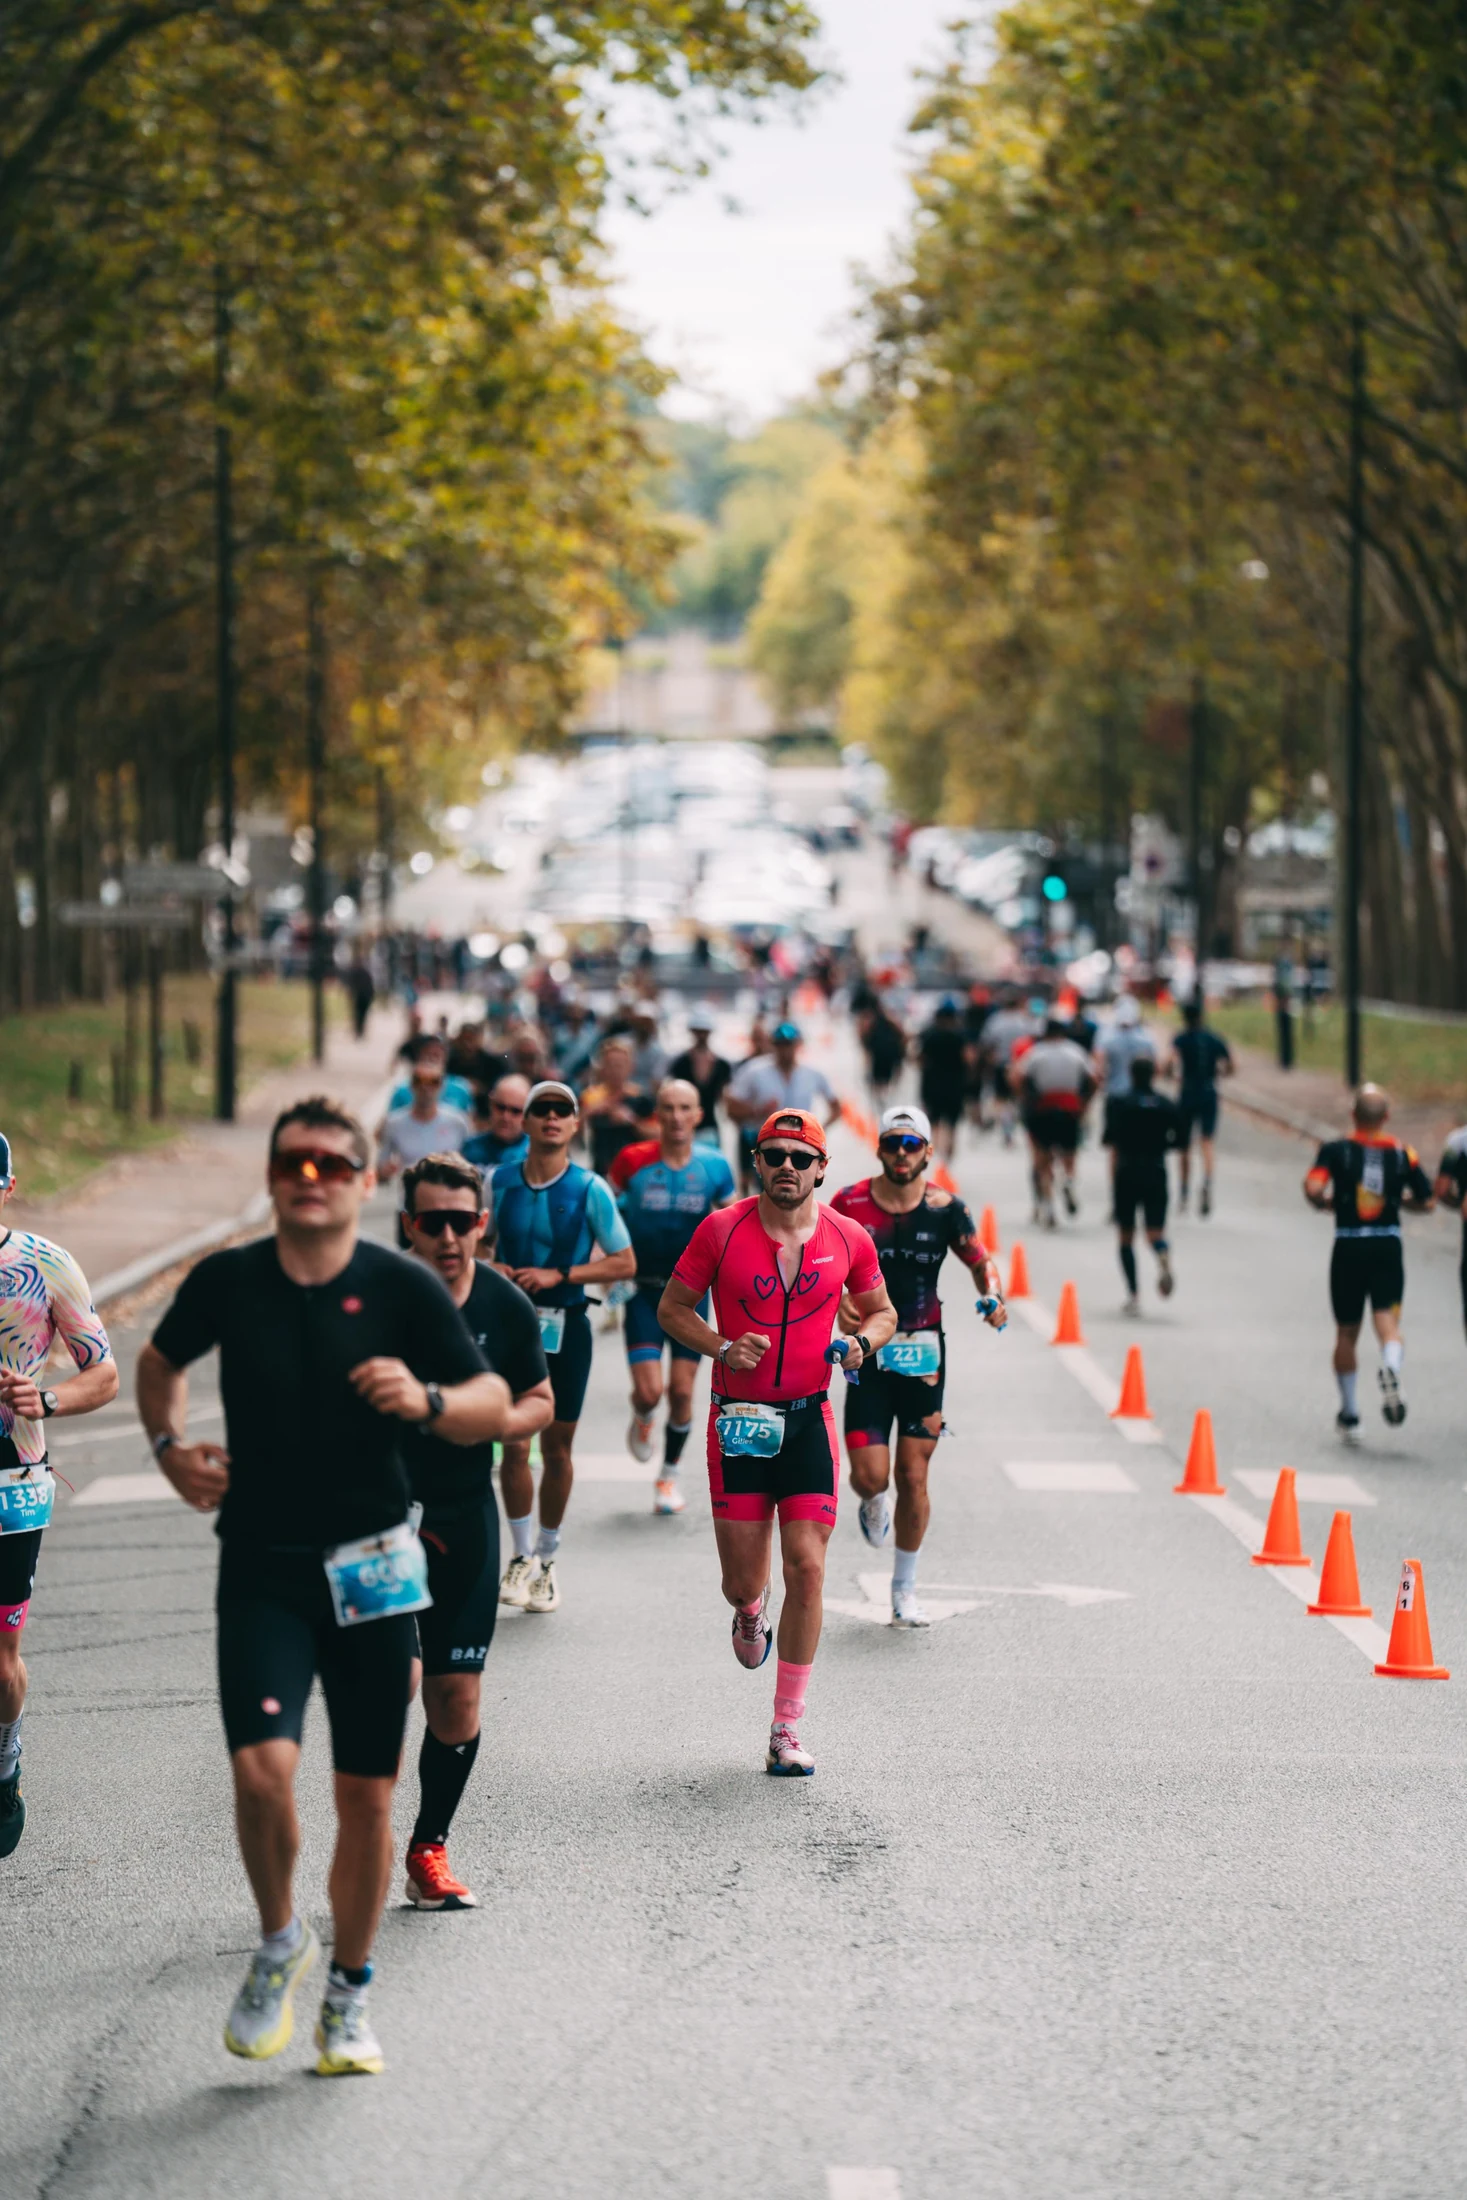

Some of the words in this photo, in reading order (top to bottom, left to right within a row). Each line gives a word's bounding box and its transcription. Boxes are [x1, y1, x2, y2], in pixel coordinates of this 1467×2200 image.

[893, 1346, 923, 1362] 221
[723, 1420, 771, 1439] 1175
[0, 1486, 48, 1511] 1338
[20, 1509, 36, 1518] Tim
[1402, 1580, 1410, 1591] 6
[1401, 1598, 1407, 1609] 1
